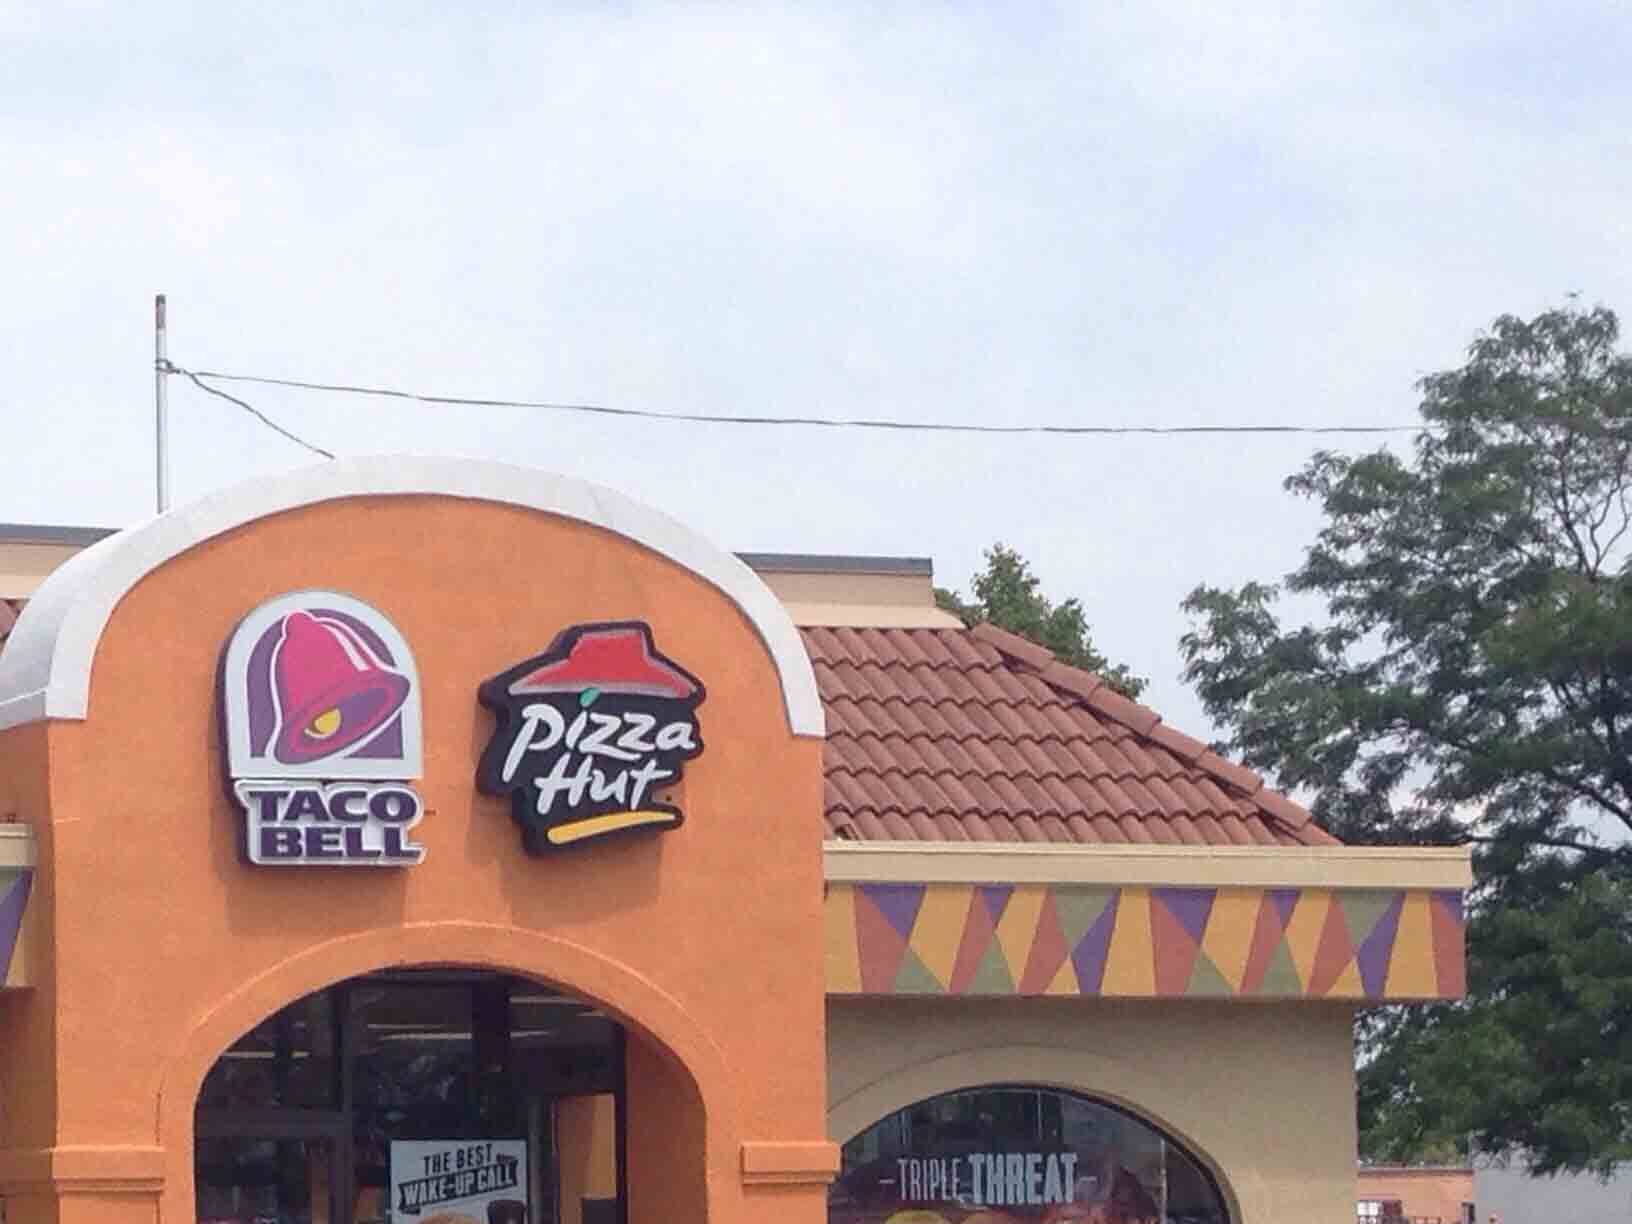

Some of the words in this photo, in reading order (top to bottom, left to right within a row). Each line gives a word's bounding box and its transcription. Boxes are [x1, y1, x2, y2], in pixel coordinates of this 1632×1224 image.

[502, 689, 695, 782] Pizza
[249, 788, 417, 822] TACO
[536, 754, 672, 813] Hut
[260, 827, 421, 859] BELL
[404, 1171, 476, 1207] WAKE-UP
[477, 1159, 515, 1192] CALL
[423, 1151, 451, 1177] THE
[456, 1143, 493, 1170] BEST
[897, 1157, 961, 1202] TRIPLE
[968, 1152, 1078, 1205] THREAT
